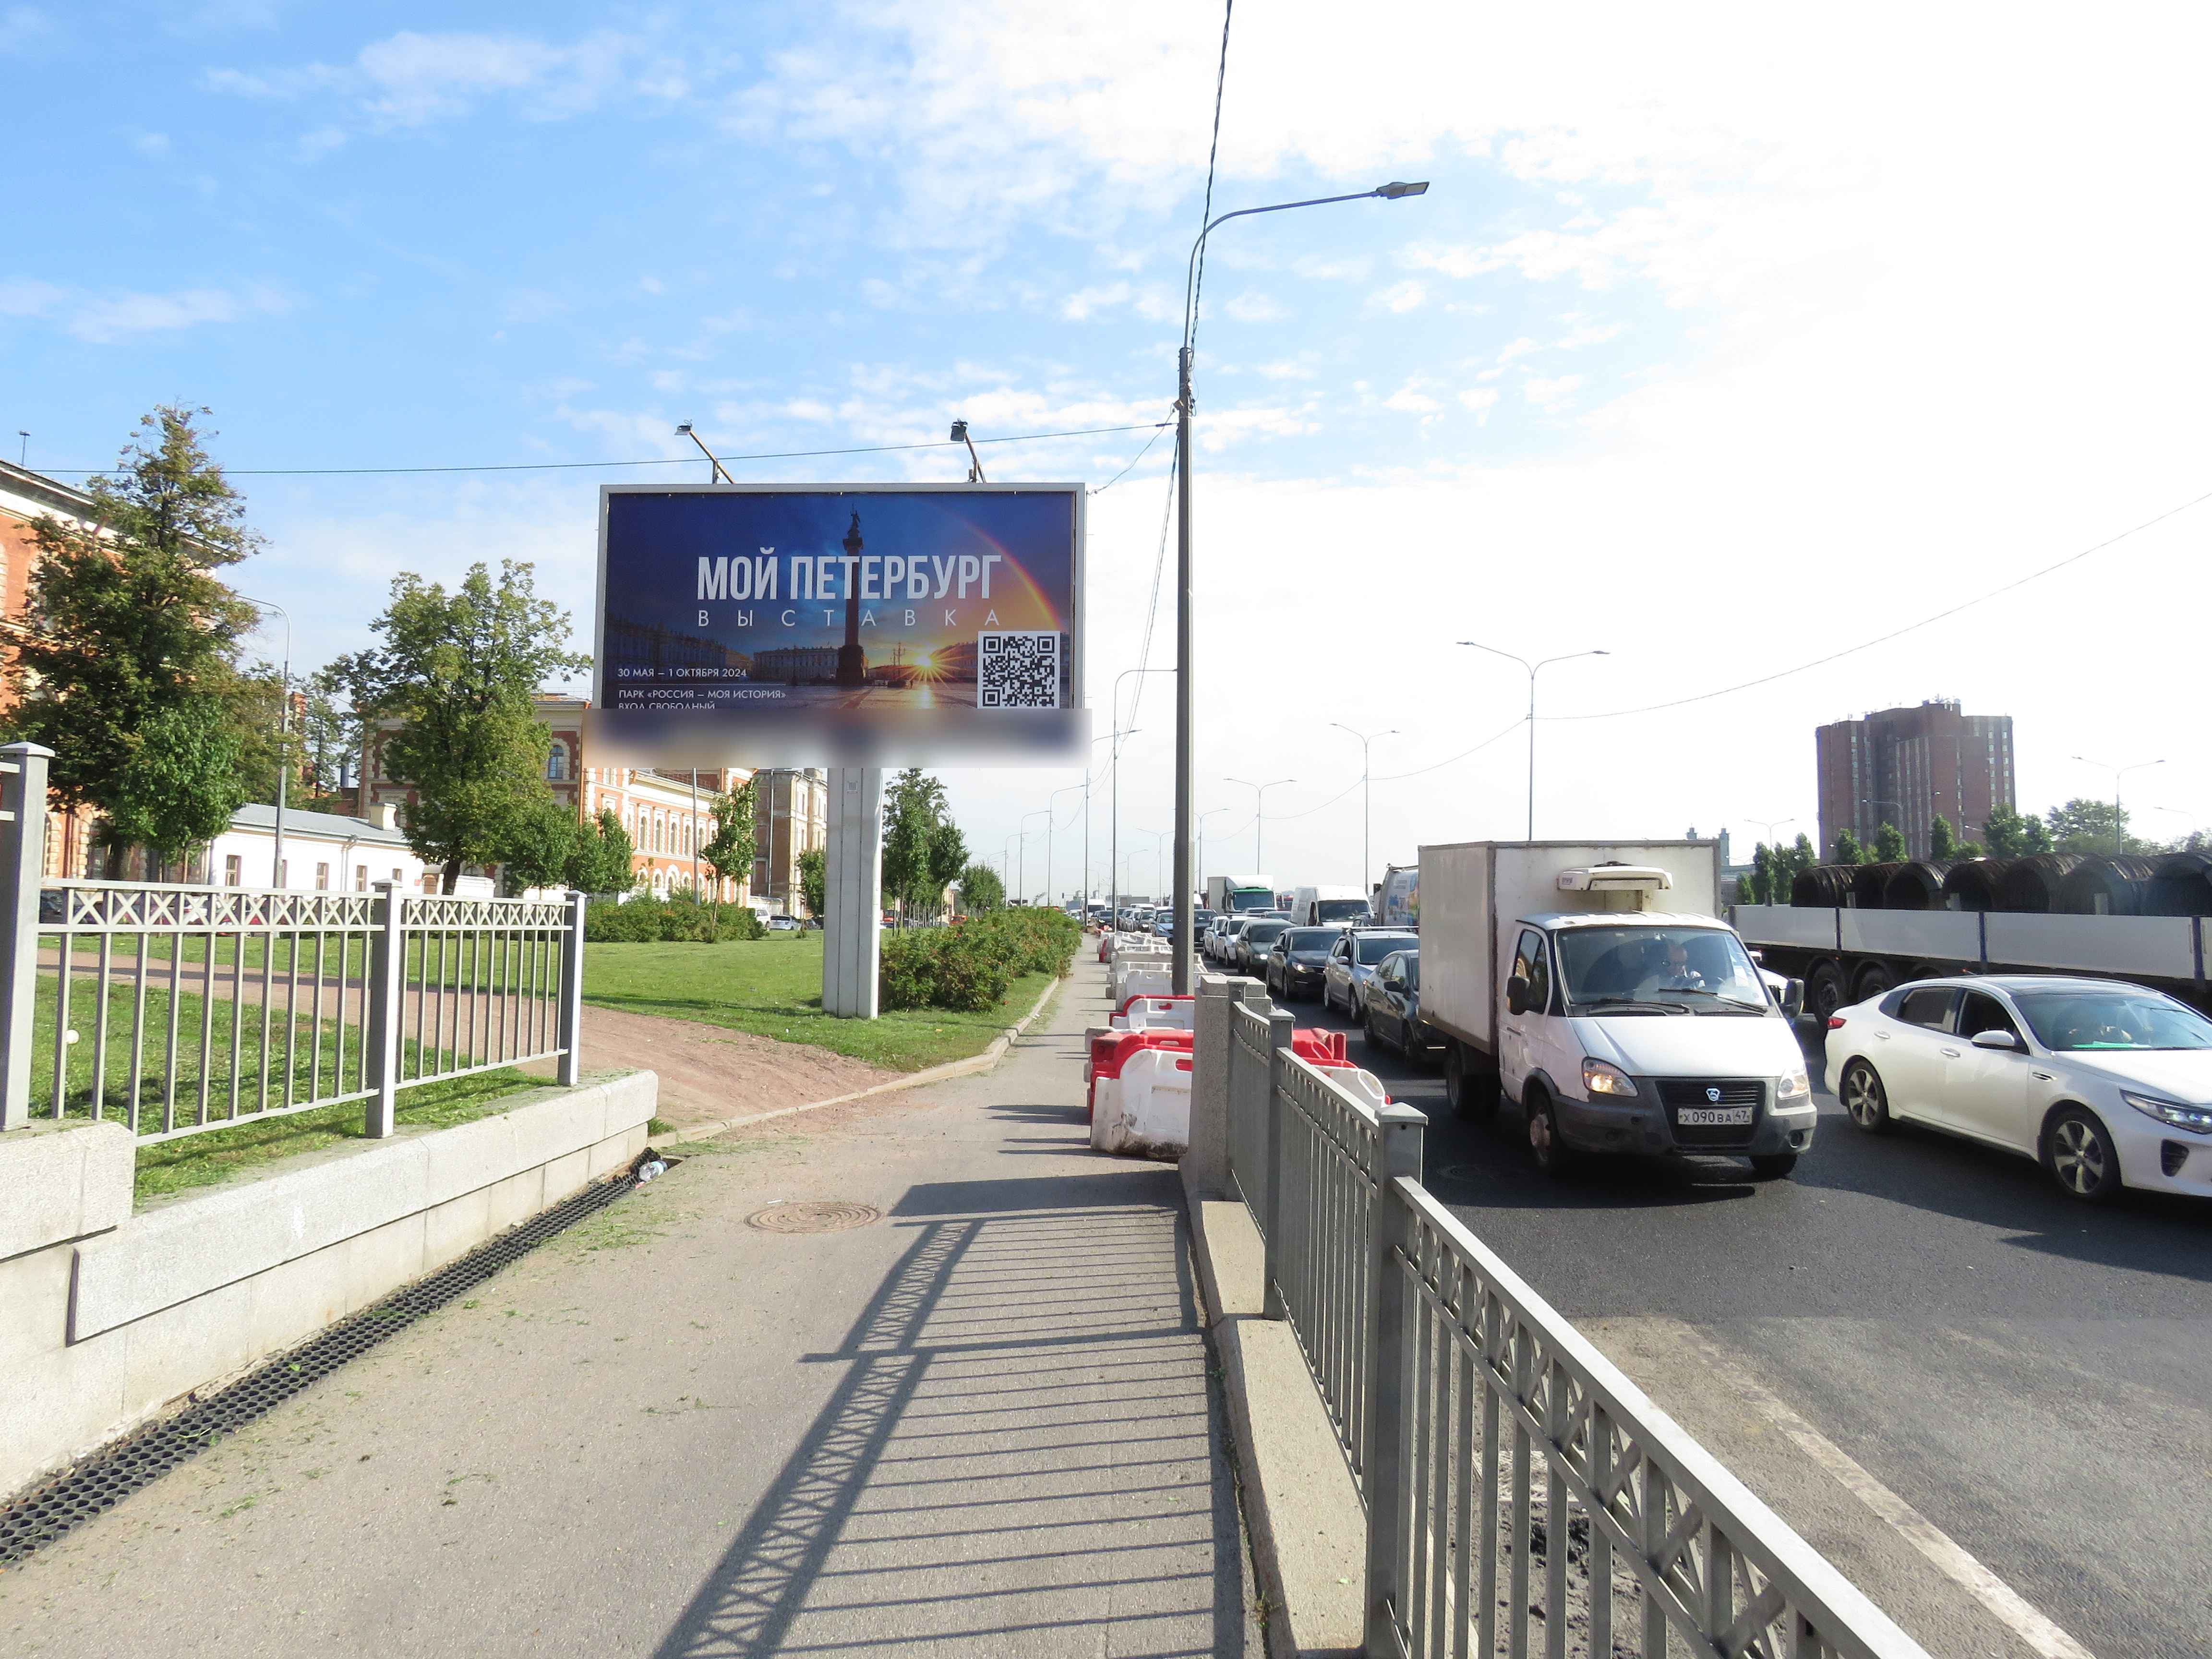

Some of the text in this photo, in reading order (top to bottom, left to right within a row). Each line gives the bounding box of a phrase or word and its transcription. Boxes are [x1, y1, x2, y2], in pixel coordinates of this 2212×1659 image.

[697, 546, 1001, 600] МОЙ ПЕТЕРБУРГ
[698, 609, 999, 626] ВЫСТАВКА
[618, 668, 630, 677] 30
[633, 668, 654, 677] МАЯ
[669, 669, 673, 677] 1
[676, 668, 719, 677] ОКТЯБРЯ
[722, 668, 746, 677] 2024
[619, 690, 645, 698] ПАРК
[647, 690, 694, 698] «РОССИЯ
[708, 690, 730, 698] МОЯ
[733, 690, 786, 698] ИСТОРИЯ»
